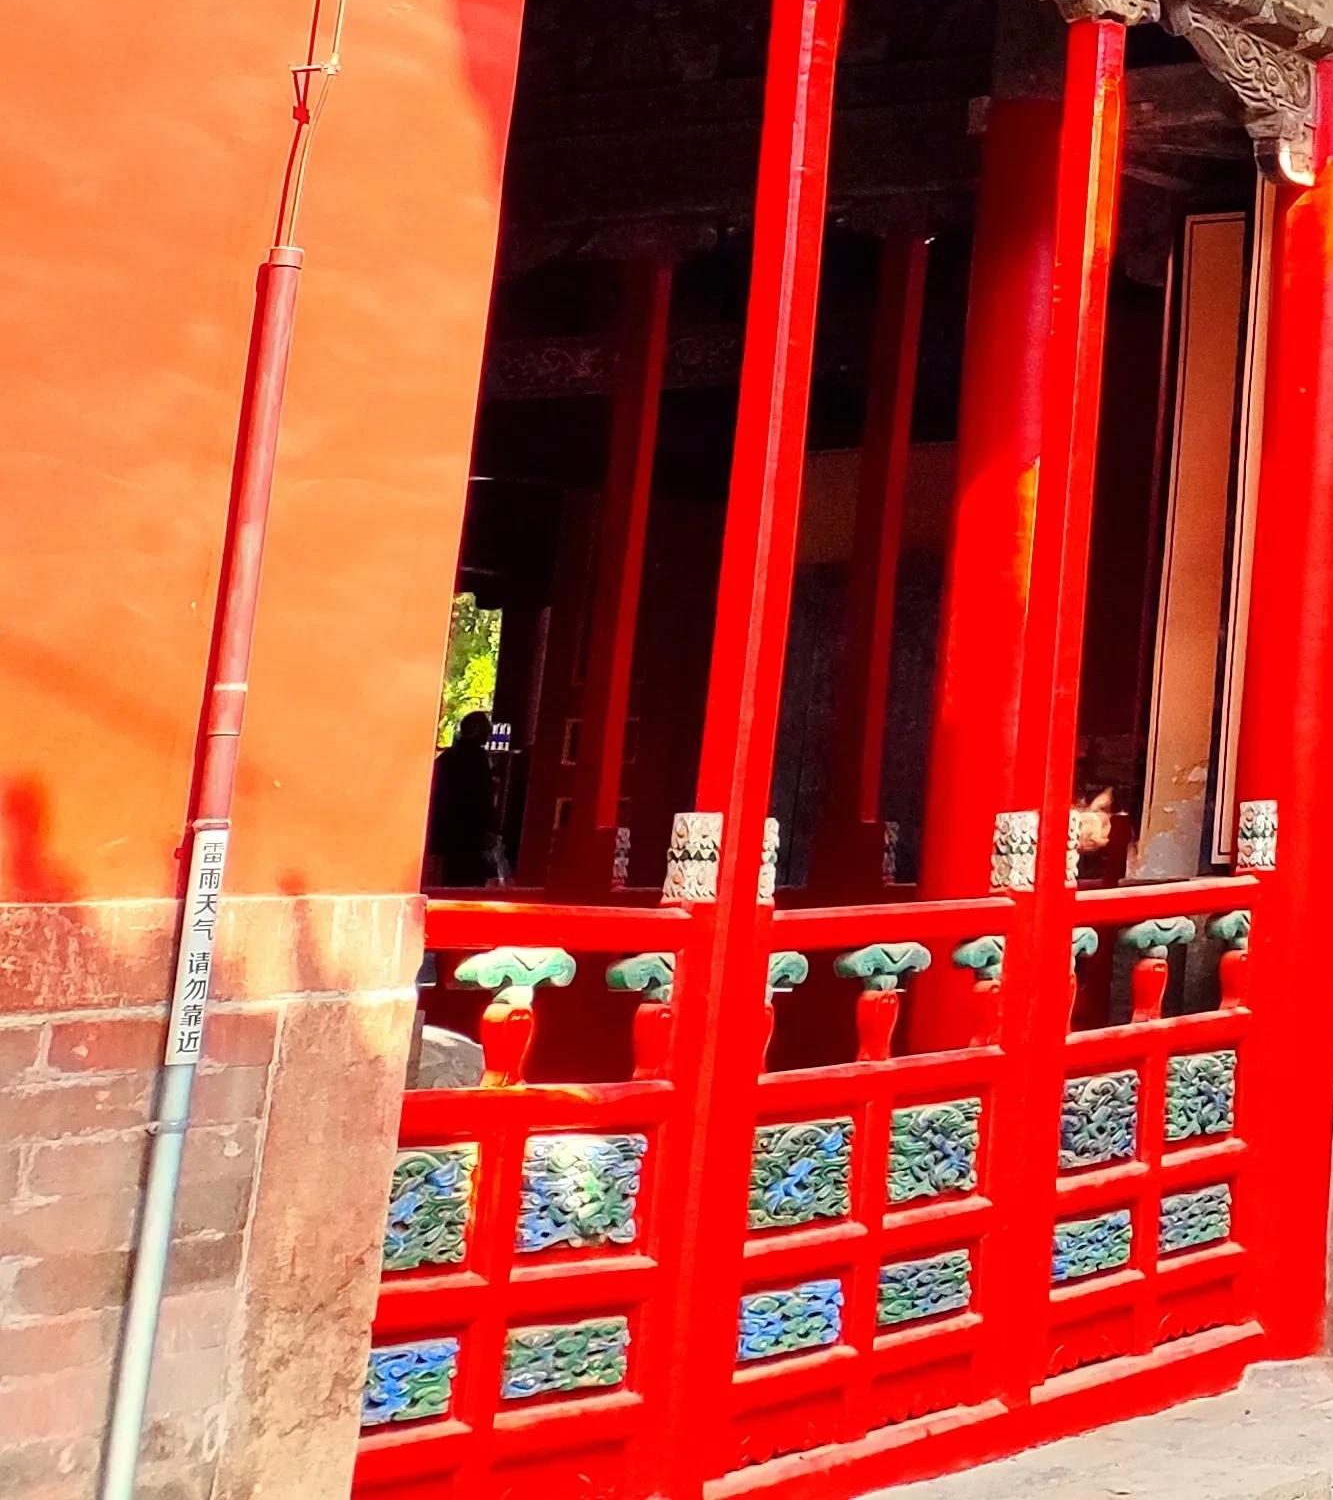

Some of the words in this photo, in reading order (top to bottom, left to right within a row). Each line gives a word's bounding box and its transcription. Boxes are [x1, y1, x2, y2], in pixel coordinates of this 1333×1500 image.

[192, 842, 225, 941] 雷雨天气
[176, 951, 211, 1054] 请勿靠近
